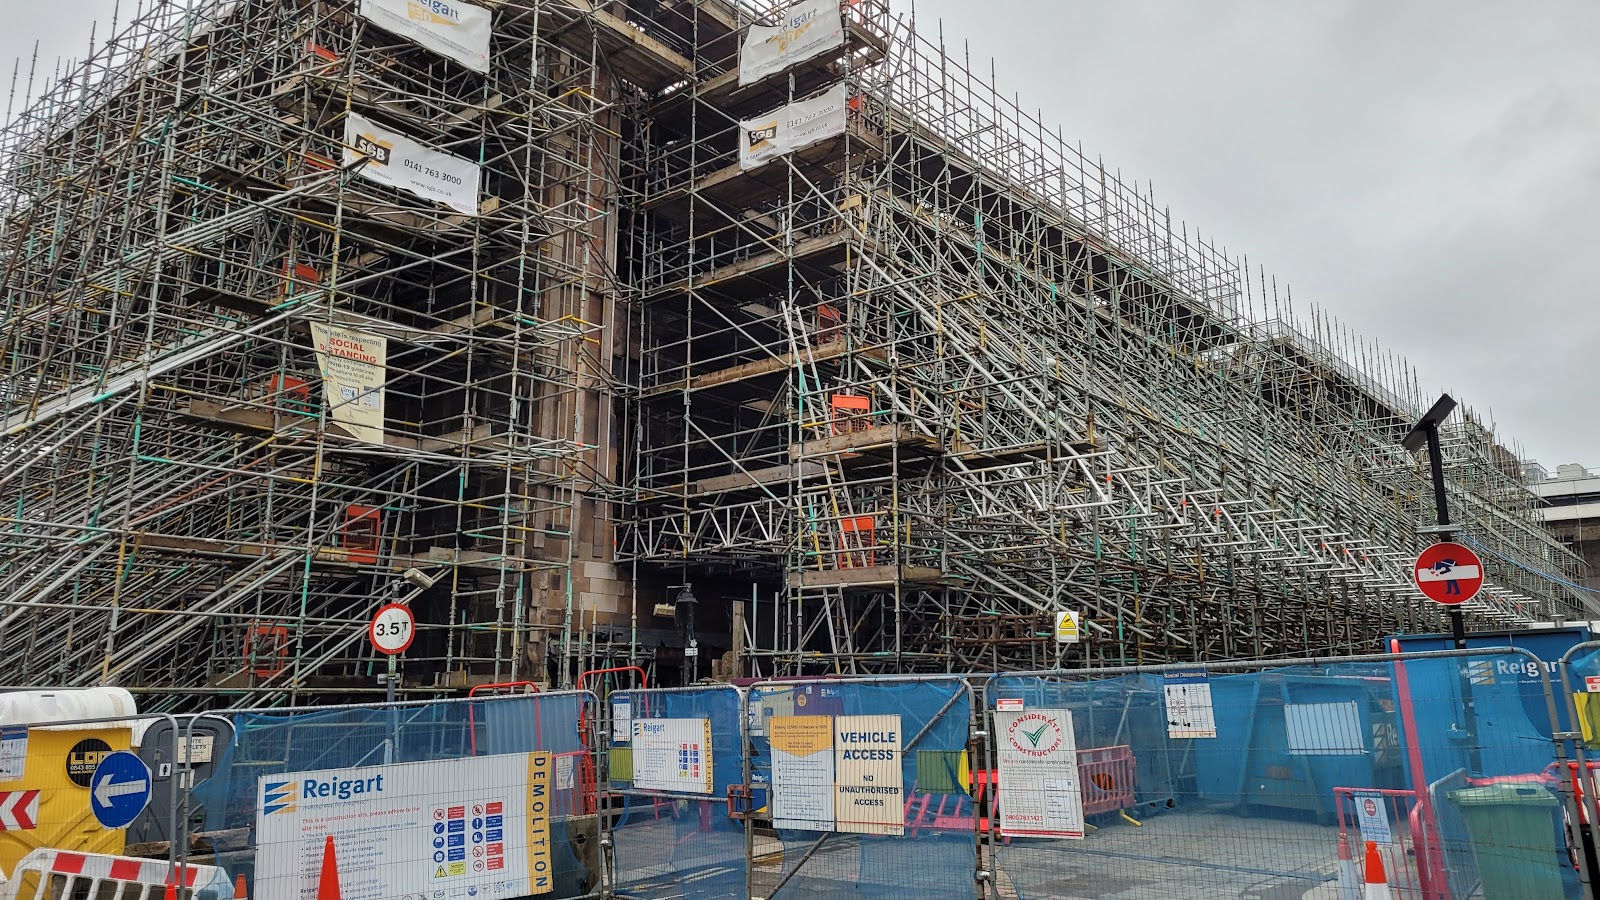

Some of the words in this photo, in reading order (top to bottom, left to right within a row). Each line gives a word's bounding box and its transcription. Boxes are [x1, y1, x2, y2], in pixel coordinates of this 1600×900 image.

[416, 0, 460, 21] eigart
[751, 129, 773, 143] SGB
[359, 139, 385, 160] SGB
[404, 159, 422, 173] 0141
[424, 167, 440, 179] 763
[441, 172, 462, 185] 3000
[410, 179, 452, 197] www.sgb.co.uk
[314, 326, 328, 334] This
[349, 335, 382, 347] respecting
[329, 337, 365, 352] SOCIAL
[320, 343, 377, 363] DSTANCING
[644, 722, 665, 733] Reigart
[1009, 713, 1061, 733] CONSIDERATE
[840, 732, 896, 743] VEHICLE
[1009, 737, 1062, 757] CONSTRUCTORS
[843, 749, 894, 760] ACCESS
[303, 774, 384, 800] Reigart
[839, 786, 899, 795] UNAUTHORISED
[325, 813, 357, 822] construction
[532, 757, 548, 888] DEMOLITION
